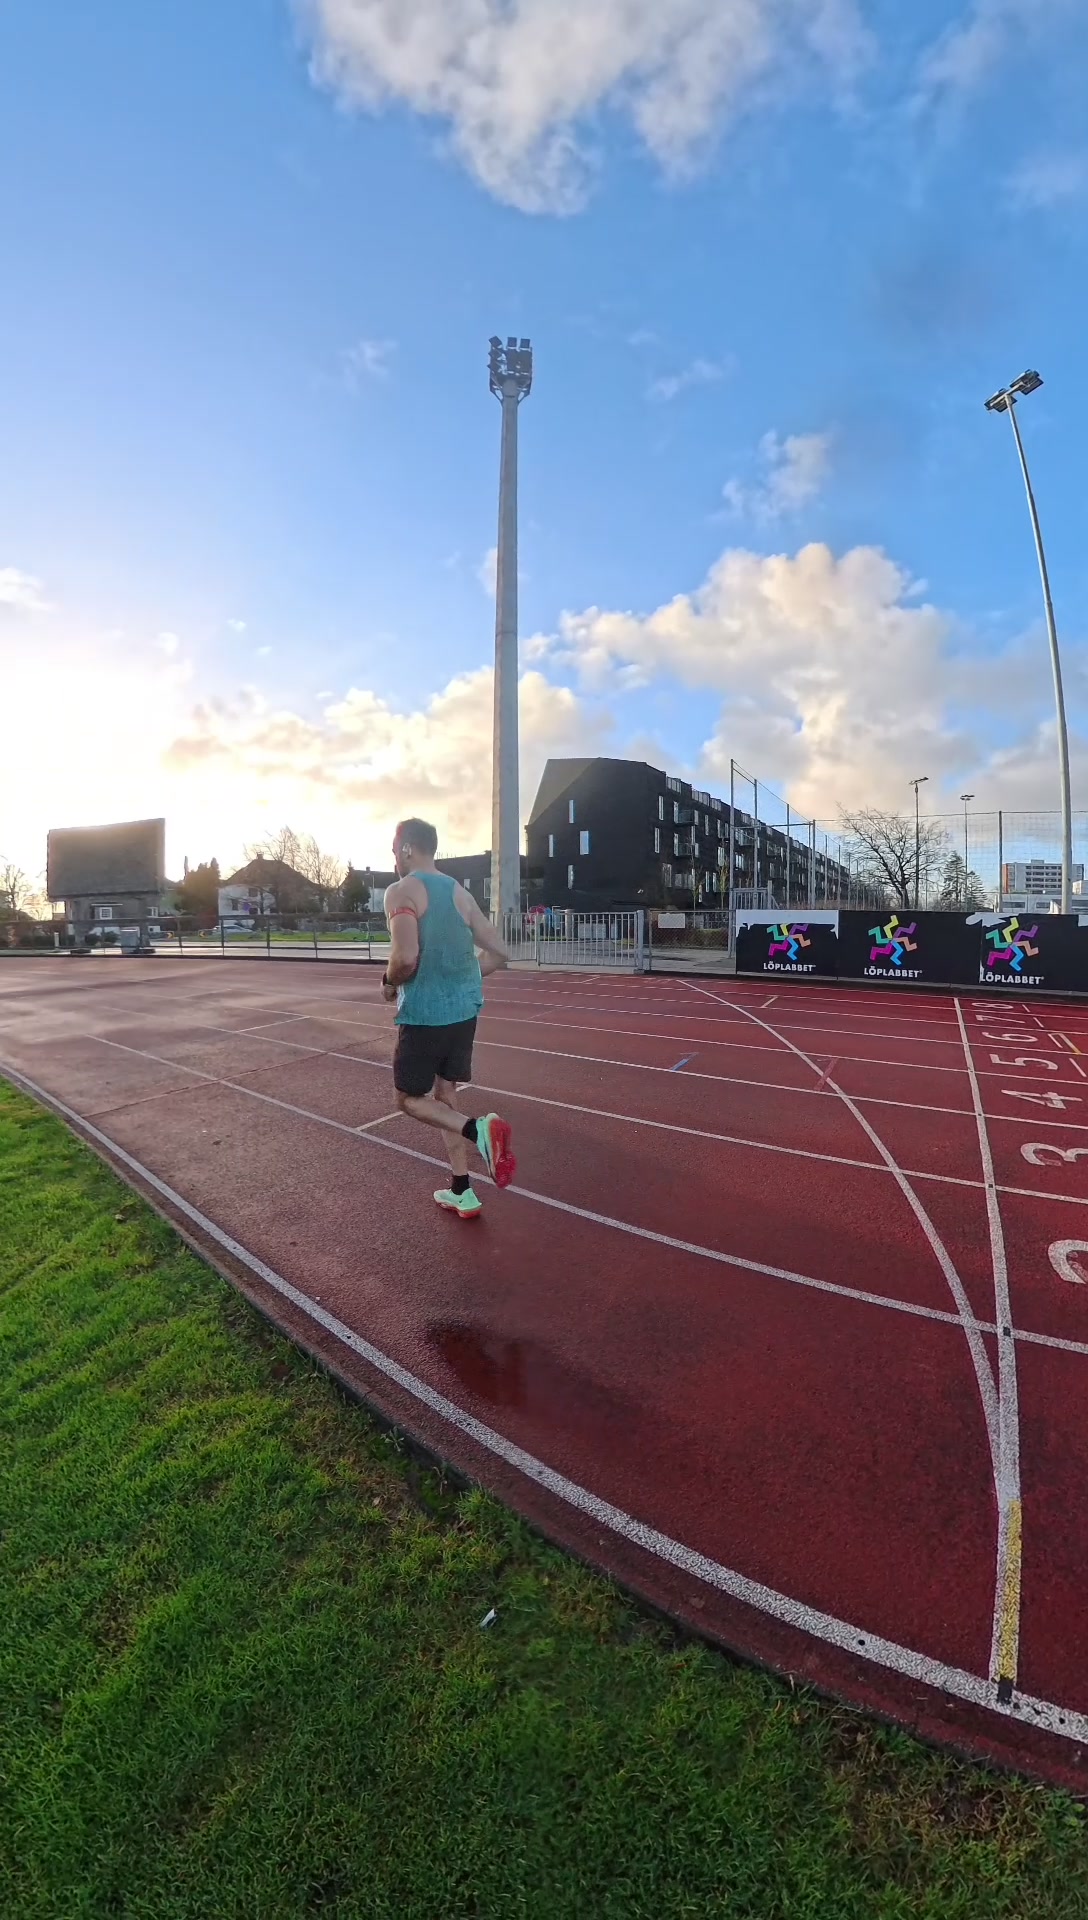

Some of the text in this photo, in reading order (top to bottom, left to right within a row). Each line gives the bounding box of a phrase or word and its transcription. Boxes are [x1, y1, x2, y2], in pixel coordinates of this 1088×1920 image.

[763, 960, 813, 972] LÖPLABBET
[863, 965, 920, 978] LÖPLABBET
[971, 1002, 1014, 1010] 8
[975, 1014, 1026, 1024] 7
[981, 1031, 1039, 1043] 6
[989, 1053, 1059, 1071] 5
[1001, 1089, 1083, 1110] 4
[1020, 1142, 1088, 1166] 3
